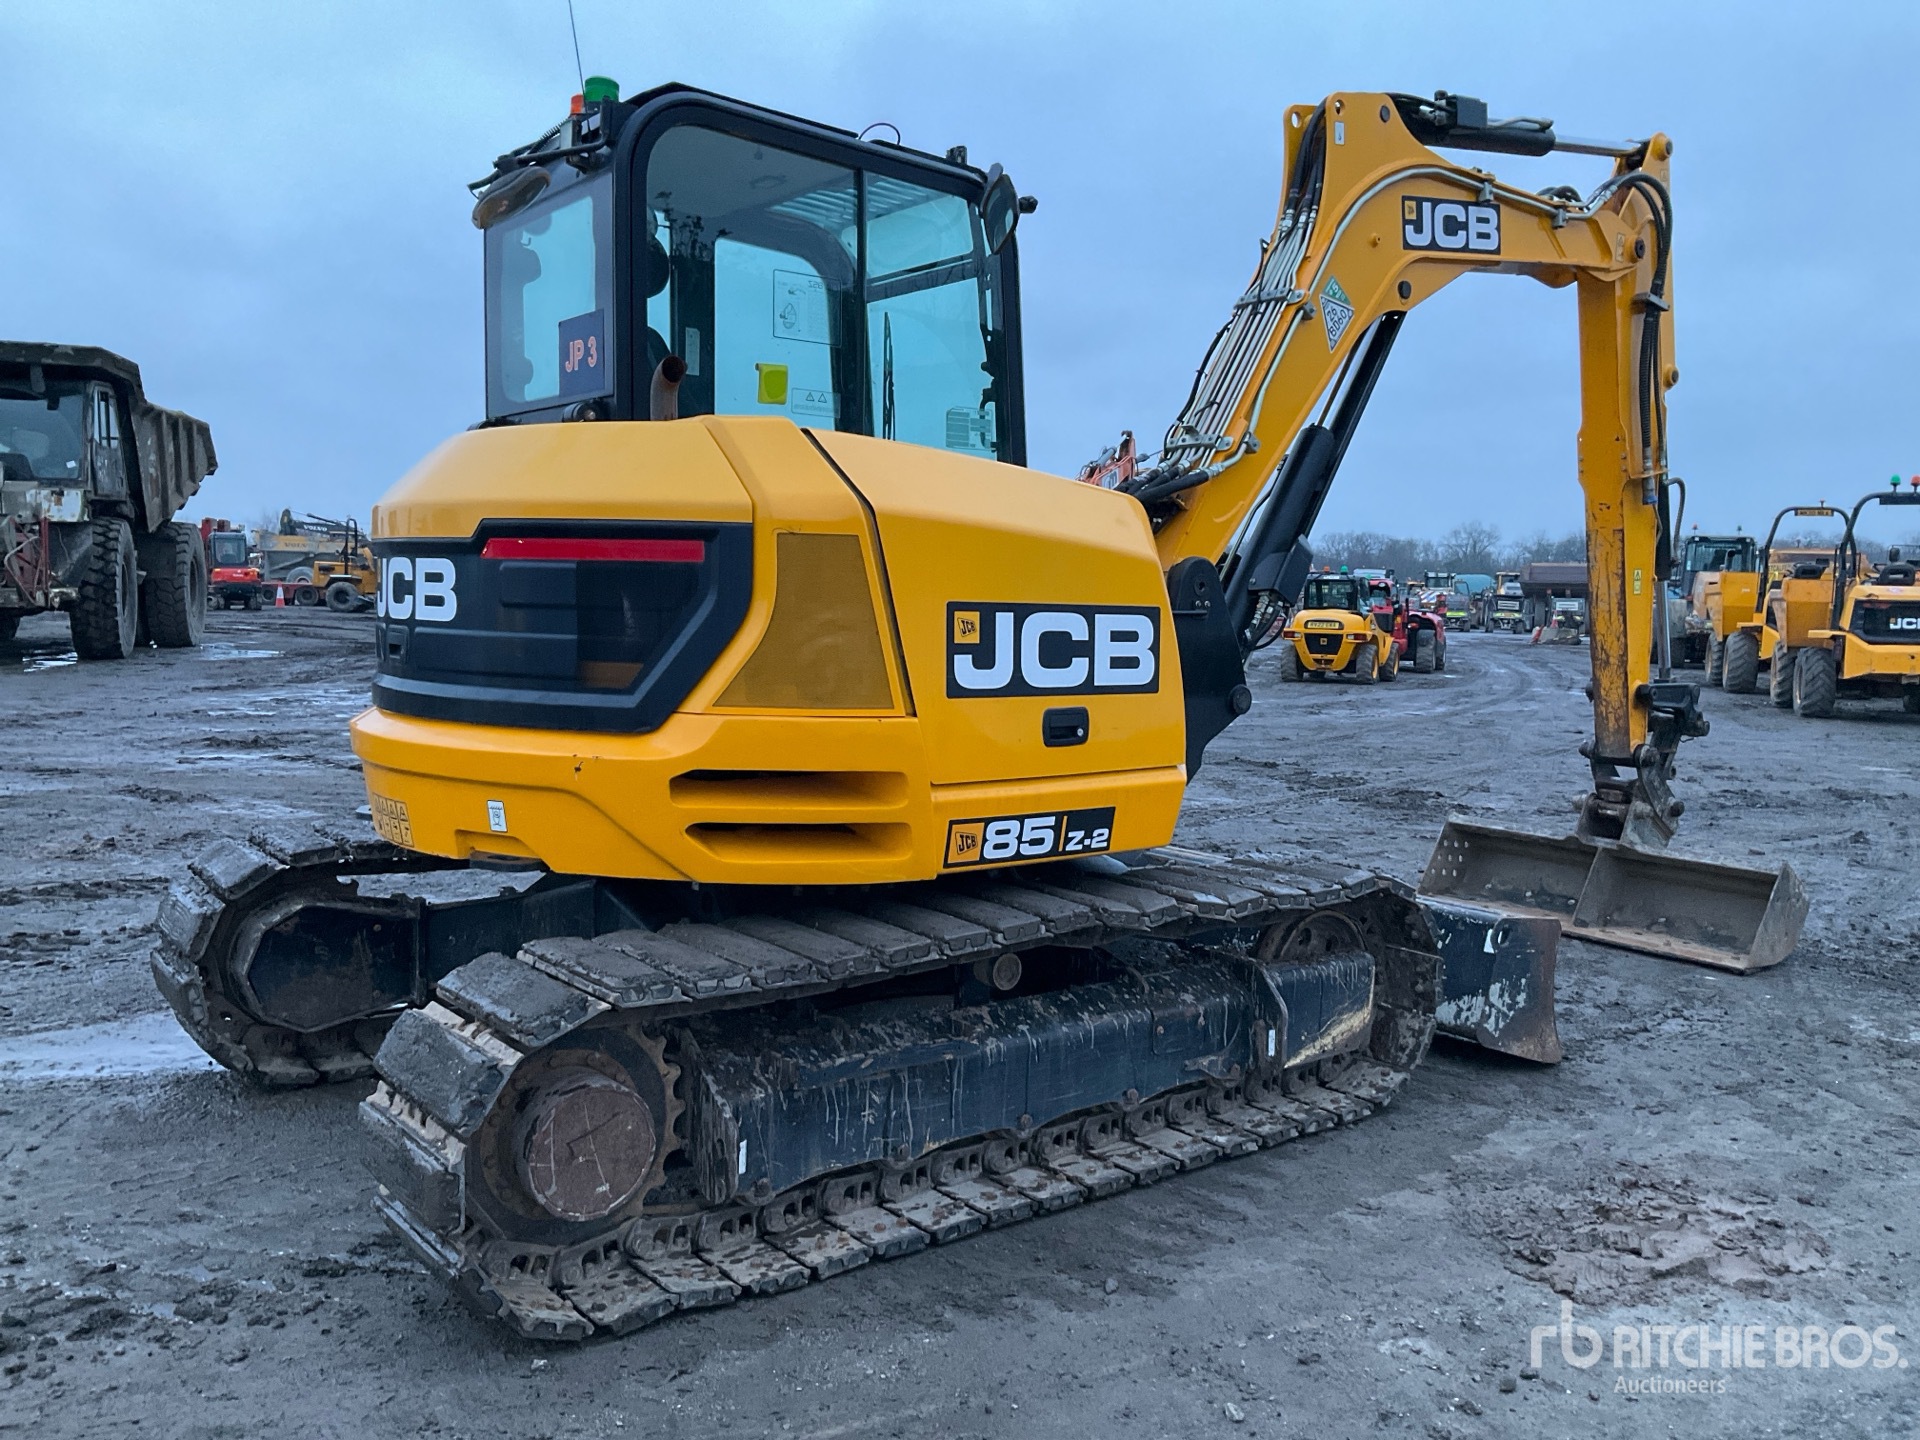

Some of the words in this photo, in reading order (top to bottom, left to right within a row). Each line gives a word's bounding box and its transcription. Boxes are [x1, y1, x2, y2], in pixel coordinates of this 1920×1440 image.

[1405, 202, 1499, 250] JCB
[565, 340, 585, 373] JP
[587, 336, 598, 368] 3
[303, 524, 328, 532] VOLVO
[377, 556, 458, 622] JCB
[953, 611, 1155, 690] JCB
[958, 833, 977, 852] JCB
[983, 816, 1056, 859] 85
